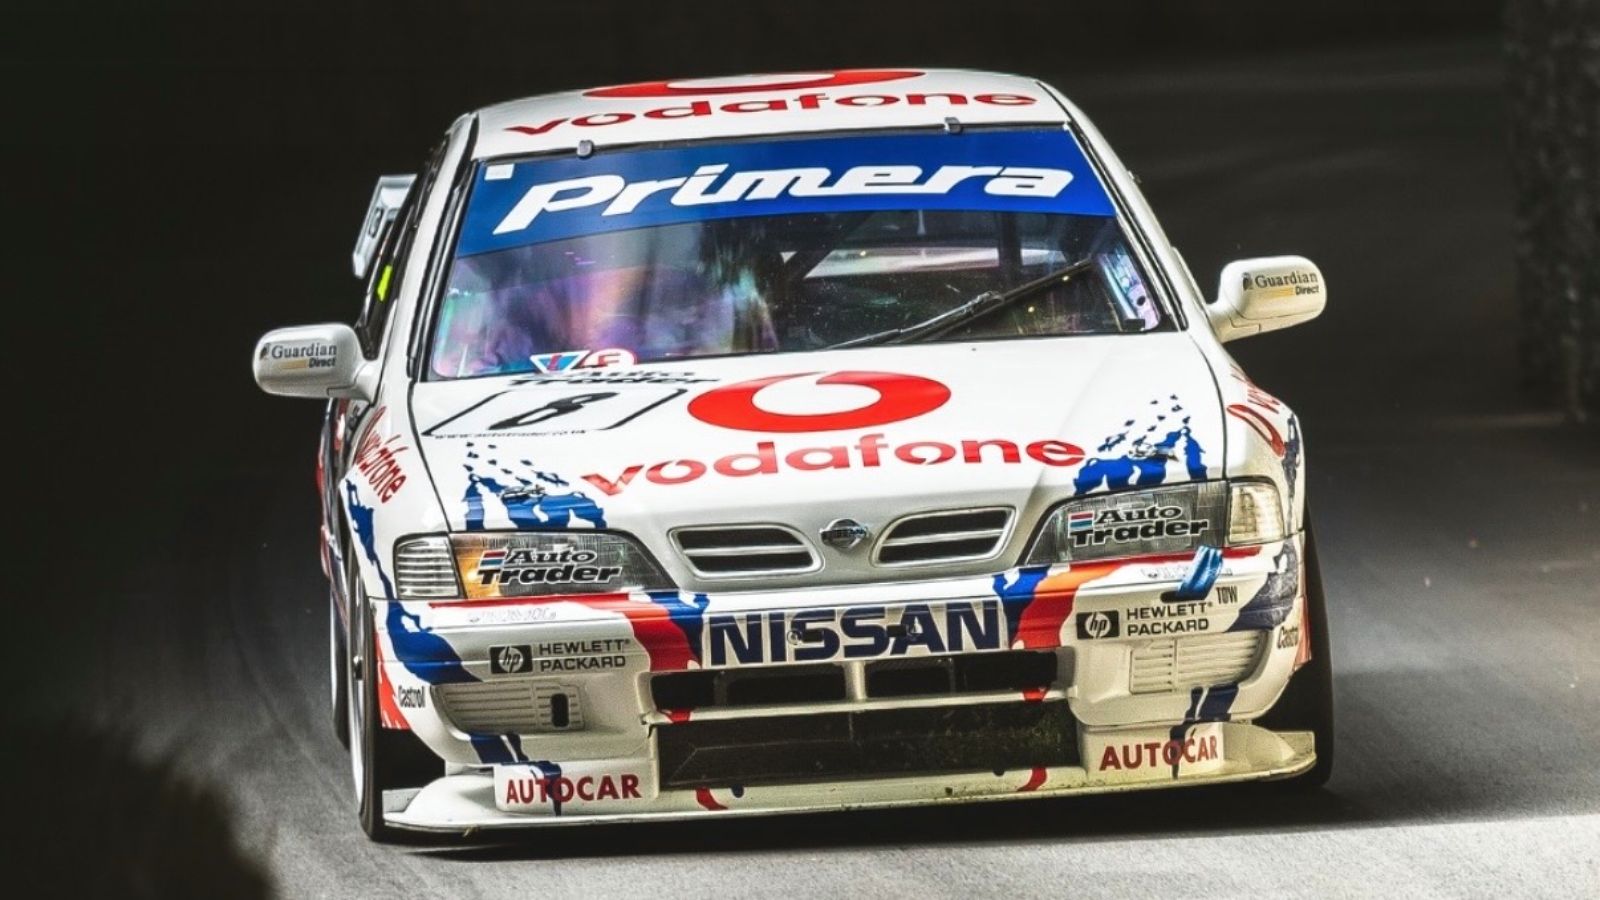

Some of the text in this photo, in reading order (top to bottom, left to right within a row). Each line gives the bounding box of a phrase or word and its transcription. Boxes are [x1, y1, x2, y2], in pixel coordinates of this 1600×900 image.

[504, 91, 1036, 136] vodafone
[492, 163, 1075, 236] Primera
[1254, 271, 1319, 289] Guardian
[1295, 286, 1320, 295] Direct
[271, 342, 338, 360] Guardian
[308, 357, 336, 369] Direct
[487, 391, 619, 431] 8
[580, 433, 1086, 496] vodafone
[1096, 506, 1182, 524] Auto
[1069, 519, 1208, 546] Trader
[506, 548, 596, 564] Auto
[477, 564, 622, 584] Trader
[1216, 586, 1238, 603] TOW
[708, 600, 1000, 667] NISSAN
[1127, 617, 1210, 637] PACKARD
[540, 655, 627, 673] PACKARD
[398, 685, 426, 708] Castrol
[1100, 734, 1219, 771] AUTOCAR
[506, 773, 642, 804] AUTOCAR
